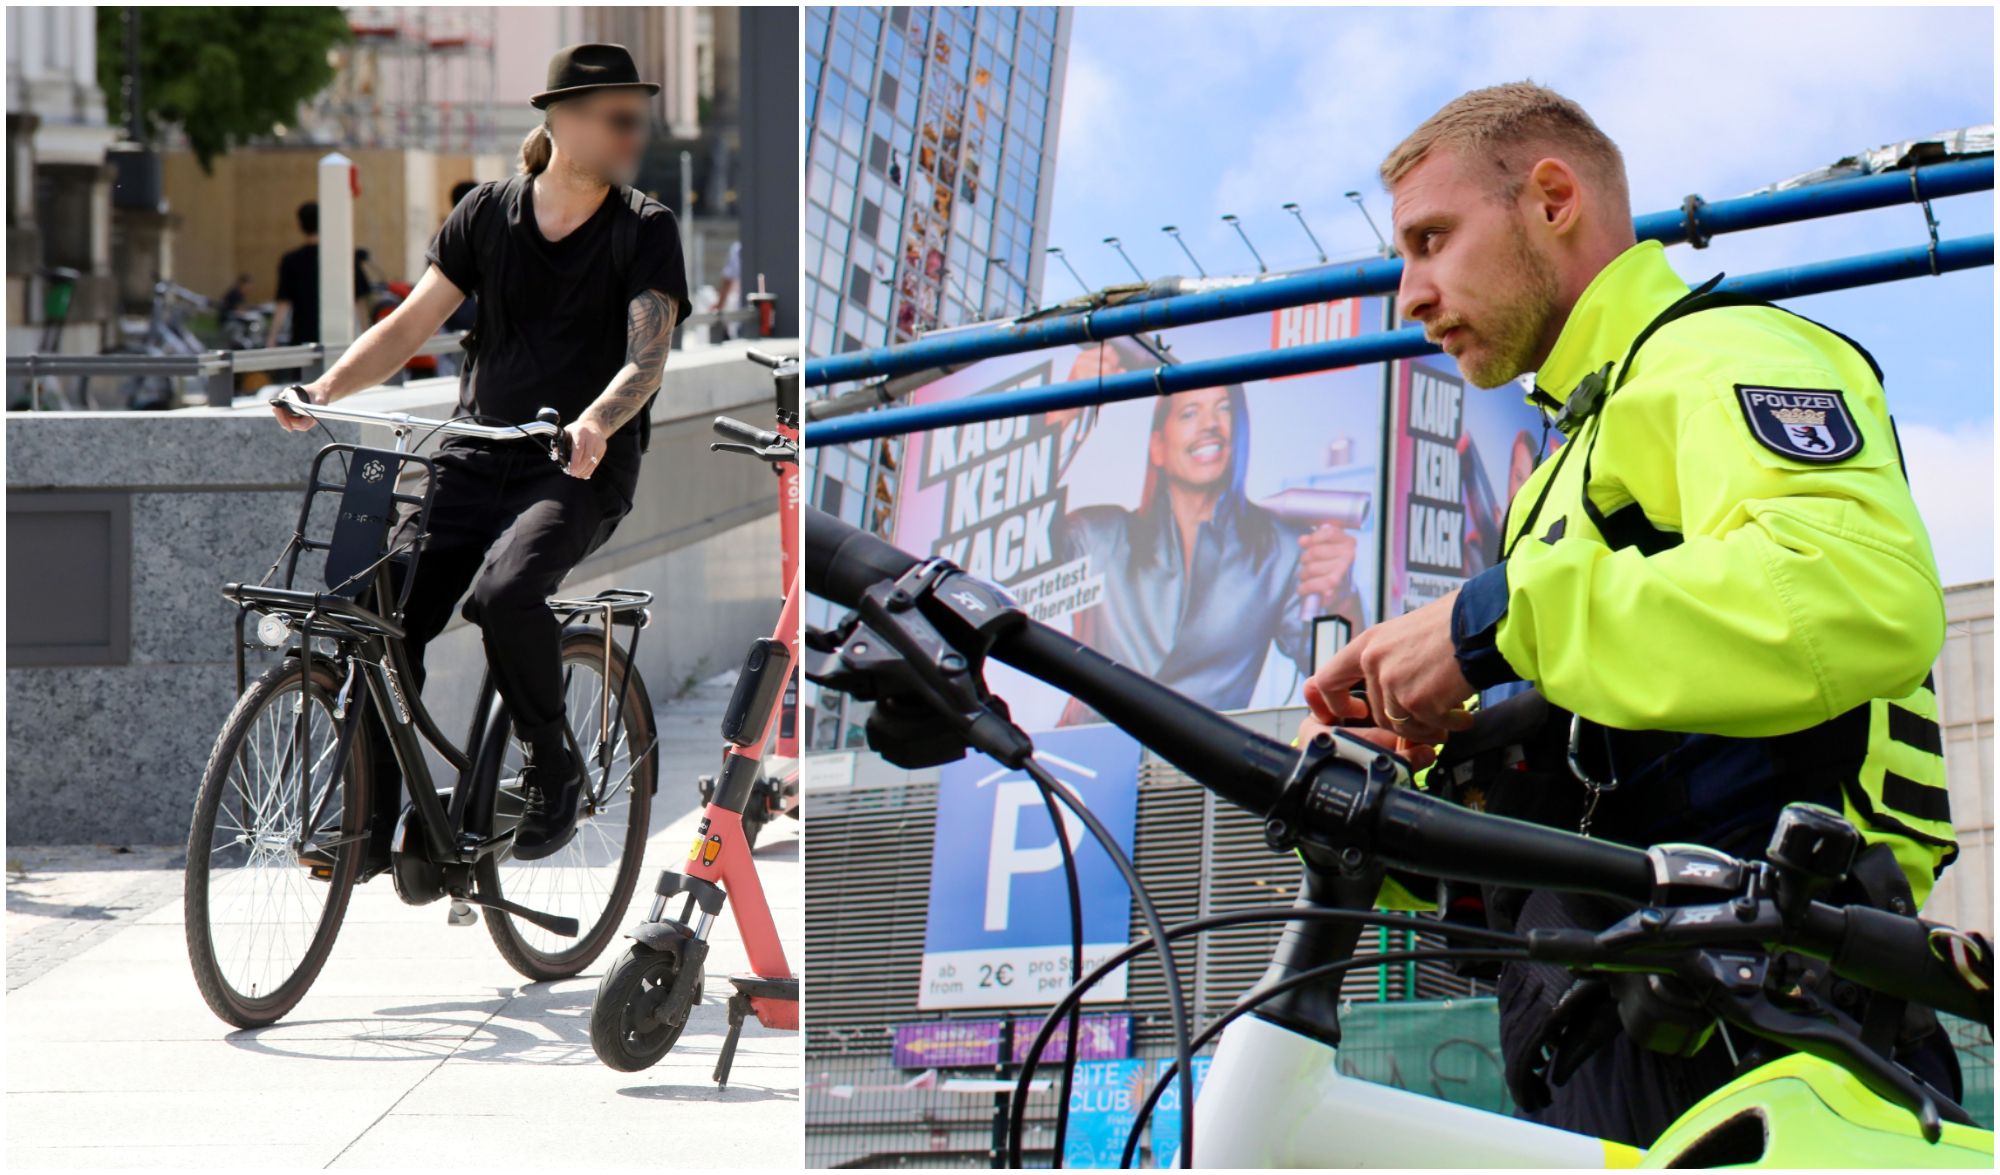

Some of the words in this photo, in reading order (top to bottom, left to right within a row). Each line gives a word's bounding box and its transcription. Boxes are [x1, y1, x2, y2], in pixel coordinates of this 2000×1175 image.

[1409, 370, 1462, 439] KAUF
[1750, 393, 1835, 409] POLIZEI
[1415, 437, 1460, 504] KEIN
[951, 434, 1053, 534] KEIN
[1409, 502, 1463, 570] KACK
[984, 777, 1086, 932] P
[938, 963, 956, 979] ab
[979, 963, 1014, 988] 2€
[1028, 959, 1054, 977] pro
[930, 979, 963, 994] from
[1038, 974, 1064, 991] per
[1072, 1062, 1120, 1086] BITE
[1069, 1088, 1131, 1112] CLUB
